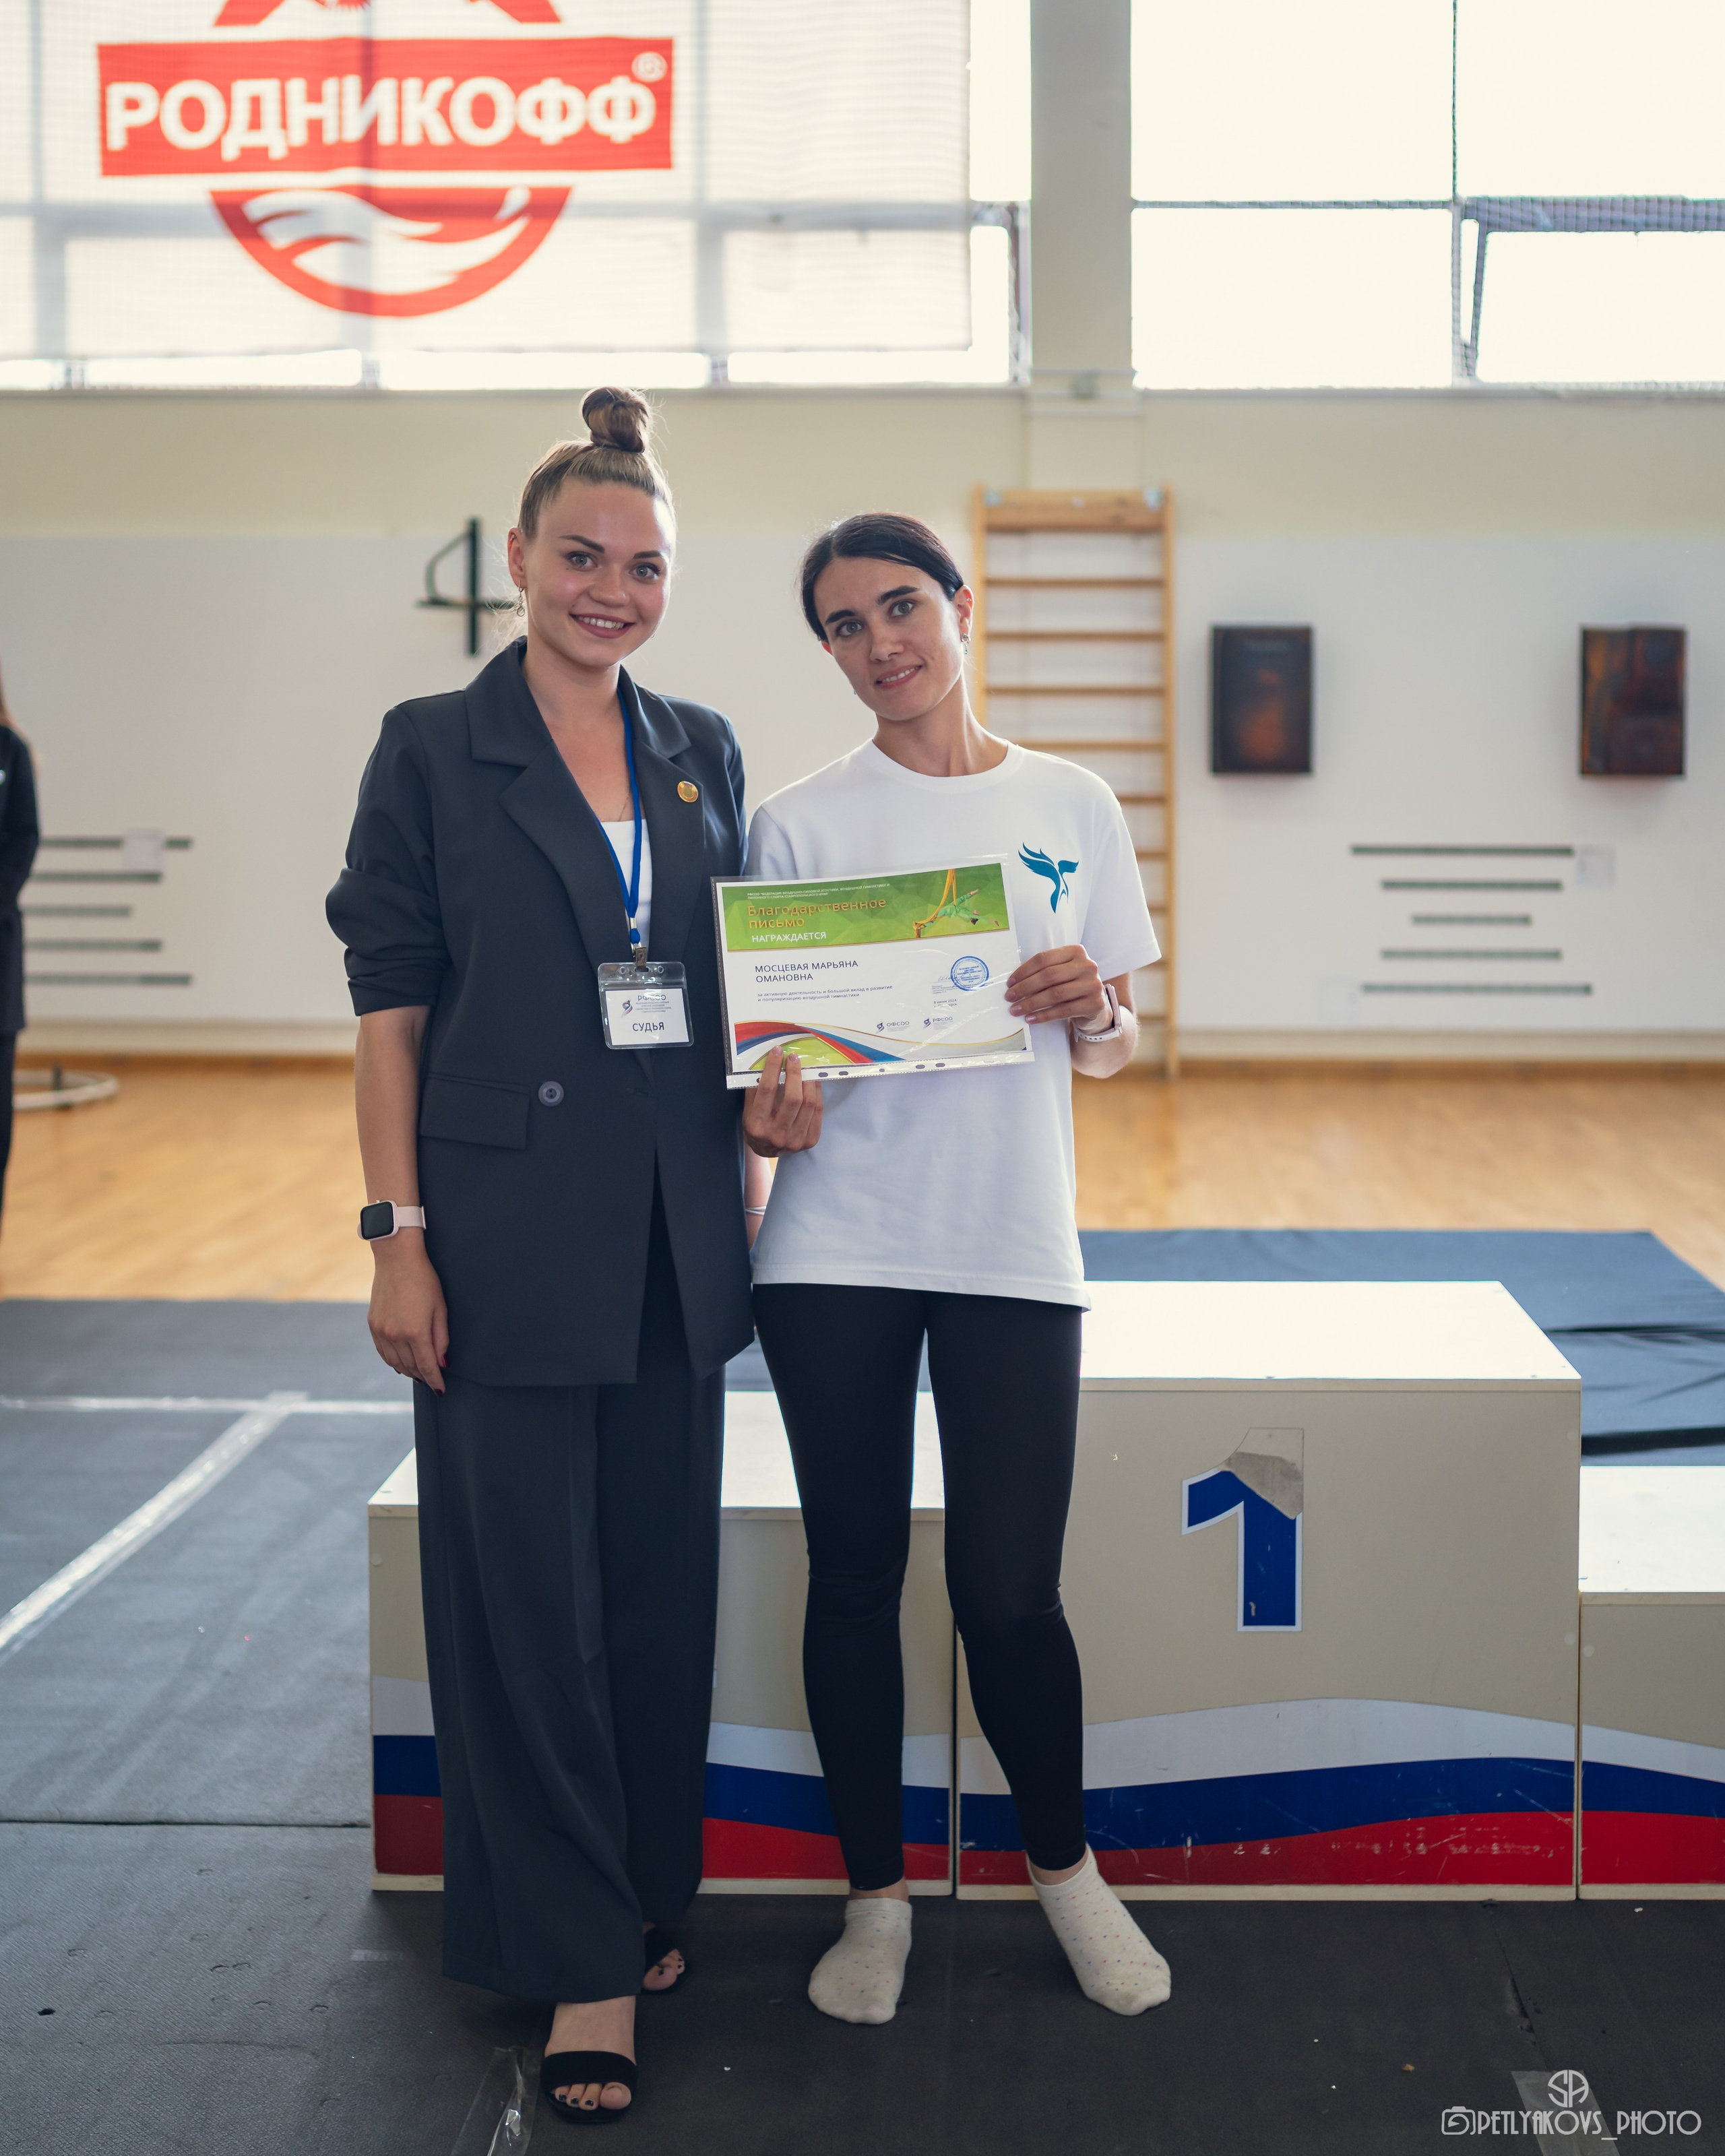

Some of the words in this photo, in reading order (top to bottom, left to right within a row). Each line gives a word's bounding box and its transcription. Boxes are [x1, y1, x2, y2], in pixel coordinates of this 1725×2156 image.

[105, 75, 656, 161] РОДНИКОФФ
[747, 899, 887, 916] Благодарственное
[749, 917, 805, 930] письмо
[751, 931, 827, 943] НАГРАЖДАЕТСЯ
[755, 963, 809, 973] МОСЦЕВАЯ
[811, 960, 858, 970] МАРЬЯНА
[755, 974, 813, 983] ОМАНОВНА
[632, 1021, 664, 1033] СУДЬЯ
[1181, 1466, 1303, 1632] 1
